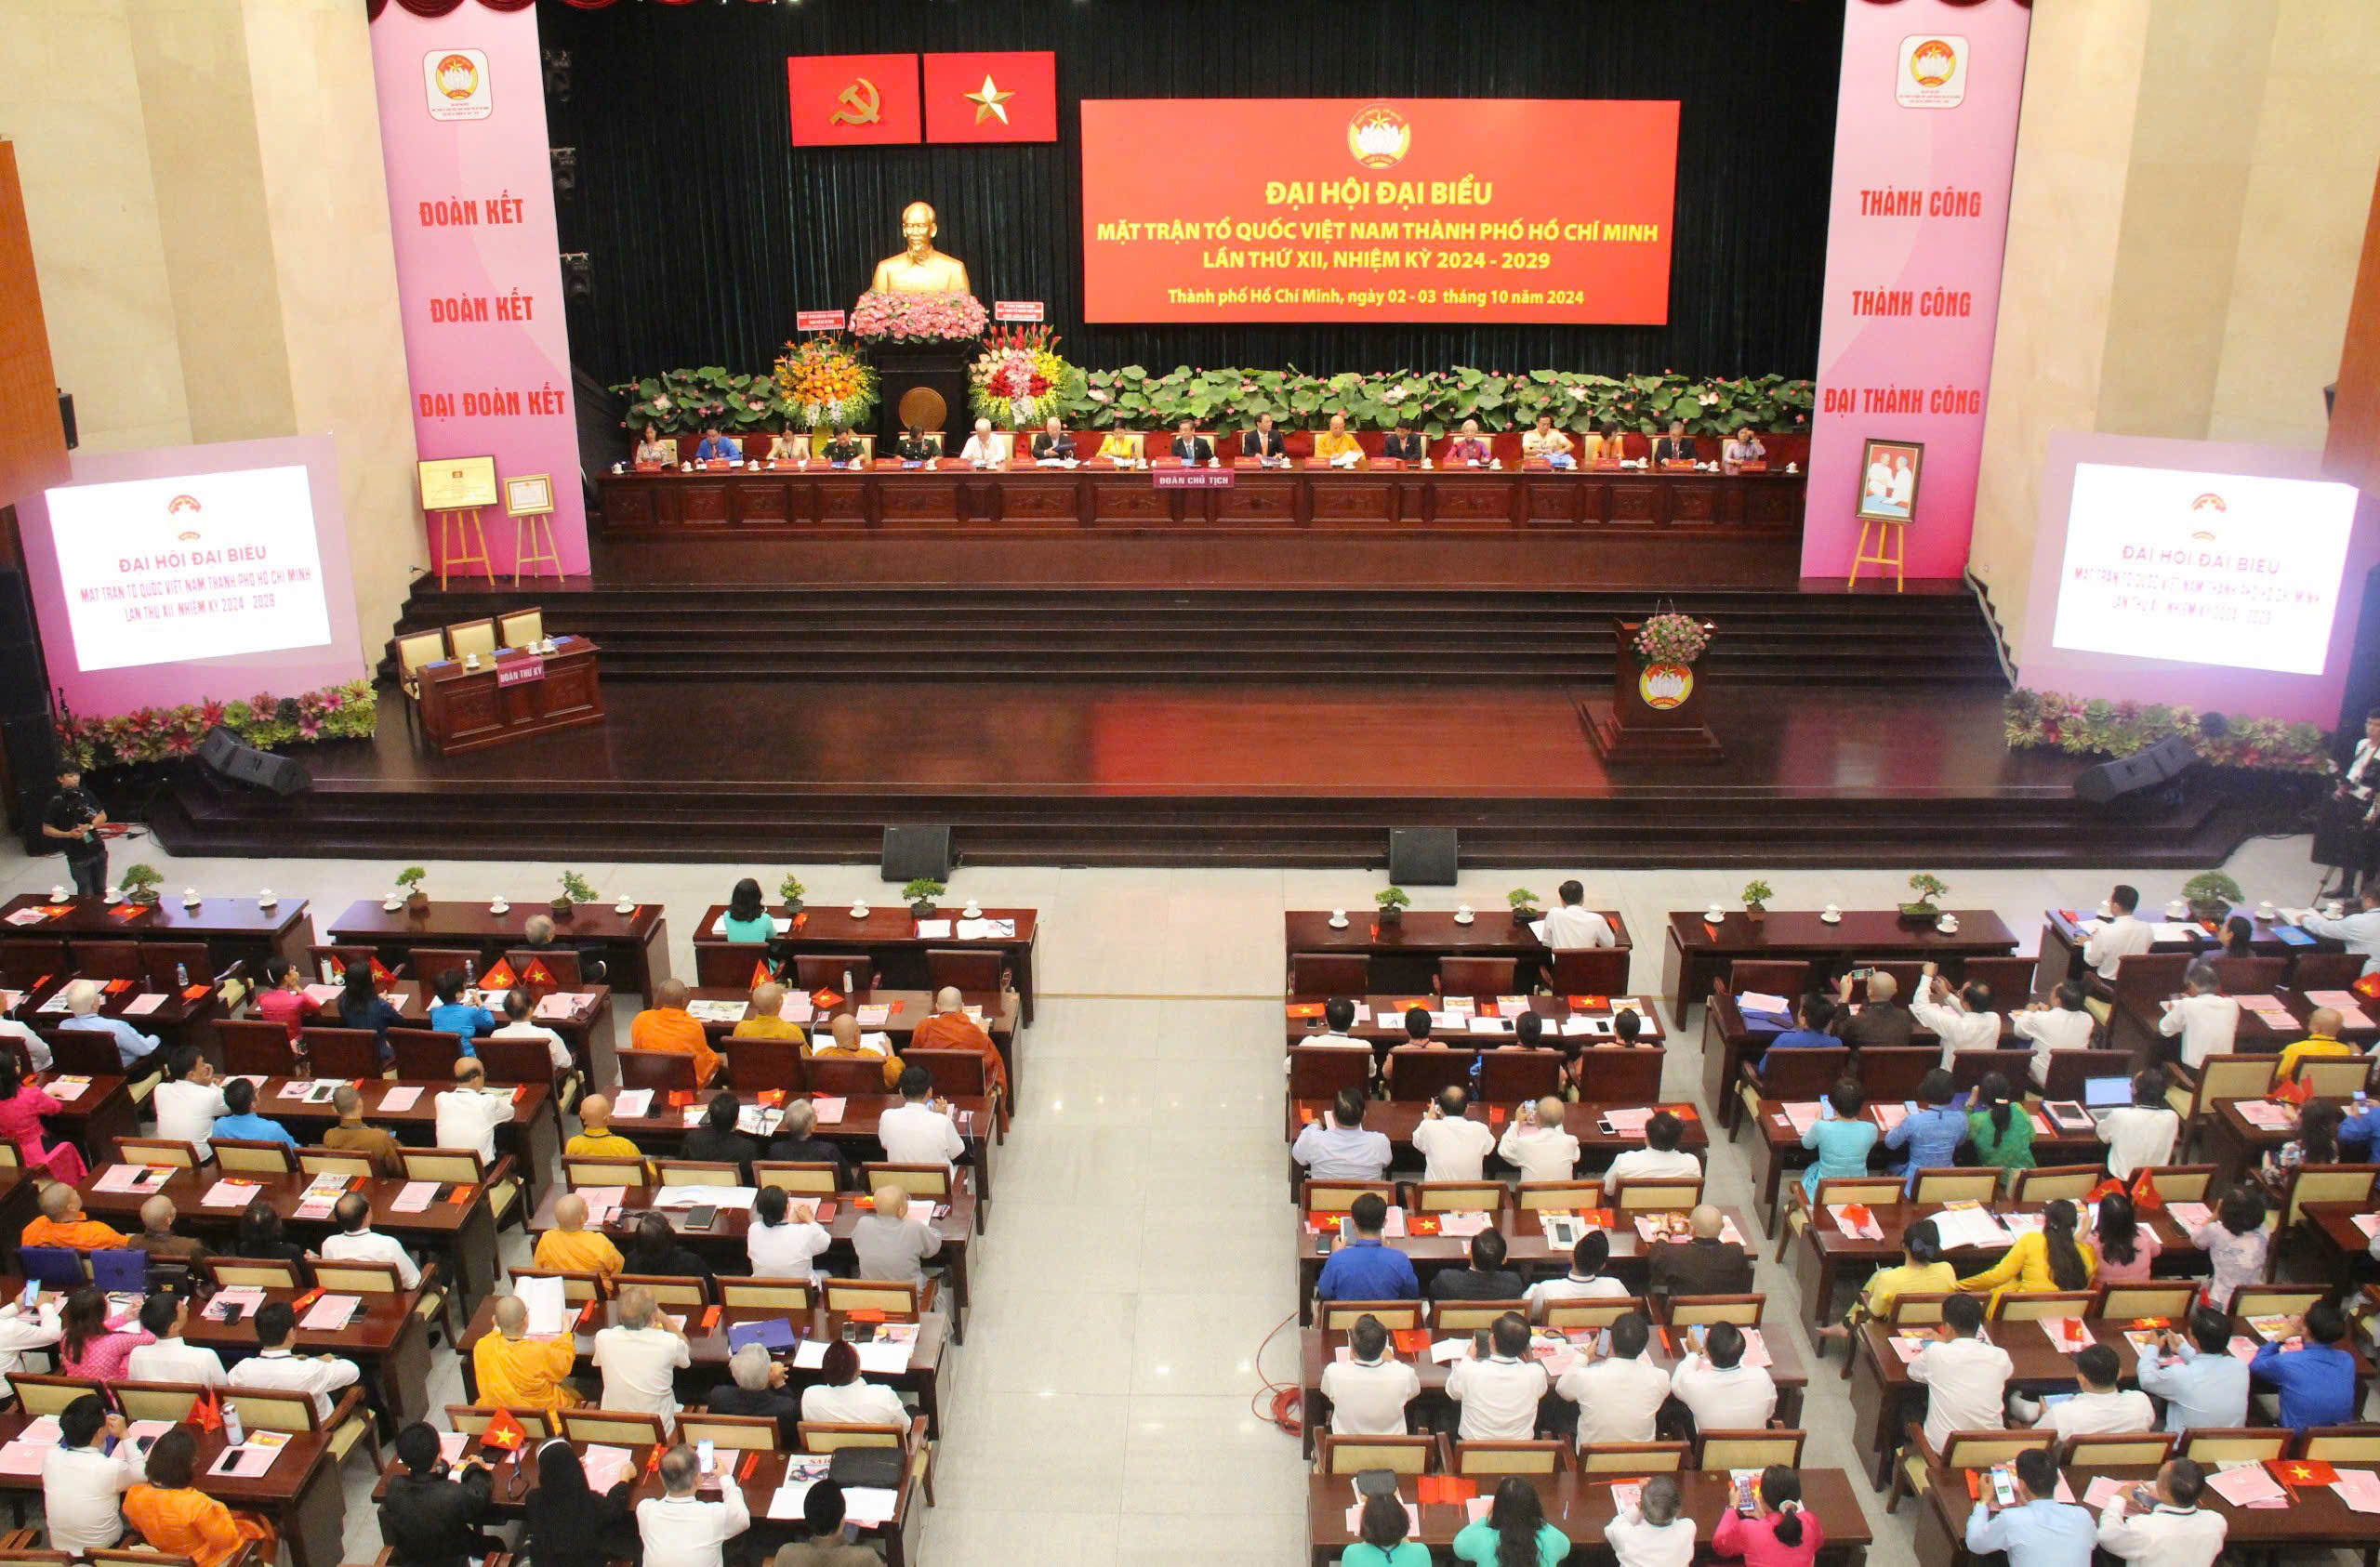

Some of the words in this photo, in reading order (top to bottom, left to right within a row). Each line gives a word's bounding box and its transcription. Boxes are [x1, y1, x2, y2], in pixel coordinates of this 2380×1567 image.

[1265, 181, 1314, 210] ĐẠI
[1321, 177, 1369, 210] HỘI
[1376, 181, 1424, 210] ĐẠI
[1431, 173, 1492, 203] BIỂU
[1860, 186, 1922, 217] THÀNH
[1929, 186, 1981, 217] CÔNG
[419, 196, 478, 226] ĐOÀN
[486, 190, 522, 224] KẾT
[1097, 219, 1142, 245] MẶT
[1144, 218, 1200, 244] TRẬN
[1203, 216, 1233, 239] TỔ
[1236, 217, 1297, 242] QUỐC
[1301, 218, 1346, 244] VIỆT
[1351, 223, 1398, 239] NAM
[1402, 219, 1475, 240] THÀNH
[1480, 217, 1524, 240] PHỐ
[1528, 218, 1559, 240] HỒ
[1564, 220, 1599, 241] CHÍ
[1603, 224, 1659, 241] MINH
[1203, 246, 1244, 268] LẦN
[1248, 247, 1293, 268] THỨ
[1297, 251, 1328, 271] XII,
[1333, 247, 1400, 272] NHIỆM
[1406, 248, 1433, 268] KỲ
[1436, 252, 1486, 268] 2024
[1501, 253, 1550, 269] 2029
[430, 292, 489, 323] ĐOÀN
[496, 287, 534, 321] KẾT
[1168, 287, 1215, 304] Thành
[1218, 285, 1249, 308] phố
[1250, 286, 1272, 303] Hồ
[1275, 287, 1299, 303] Chí
[1302, 288, 1344, 306] Minh,
[1348, 289, 1384, 308] ngày
[1388, 290, 1406, 303] 02
[1418, 290, 1435, 303] 03
[1443, 288, 1487, 308] tháng
[1491, 290, 1508, 303] 10
[1512, 290, 1543, 303] năm
[1547, 290, 1584, 304] 2024
[1852, 285, 1913, 317] THÀNH
[1920, 286, 1971, 317] CÔNG
[418, 392, 455, 422] ĐẠI
[463, 387, 522, 417] ĐOÀN
[528, 381, 565, 415] KẾT
[1824, 388, 1857, 417] ĐẠI
[1864, 384, 1924, 414] THÀNH
[1930, 384, 1980, 415] CÔNG
[1187, 475, 1206, 484] CHỦ
[1209, 477, 1228, 486] TỊCH
